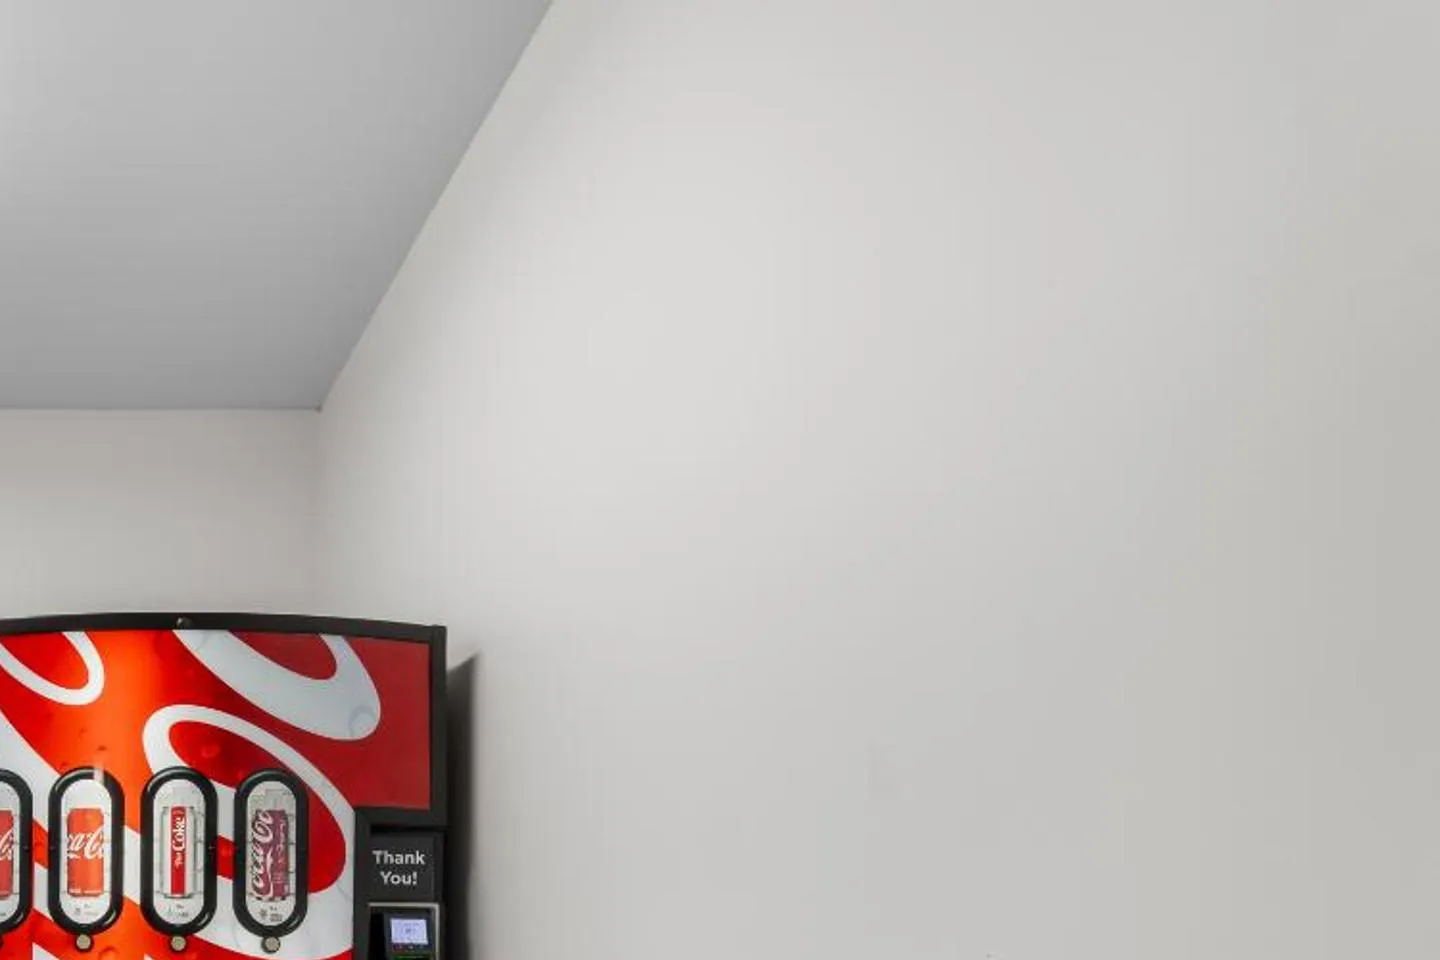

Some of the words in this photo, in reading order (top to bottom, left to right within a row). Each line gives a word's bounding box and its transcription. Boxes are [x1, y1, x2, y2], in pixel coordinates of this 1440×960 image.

[172, 816, 185, 851] Coke
[372, 850, 425, 865] Thank
[380, 871, 418, 886] You!
